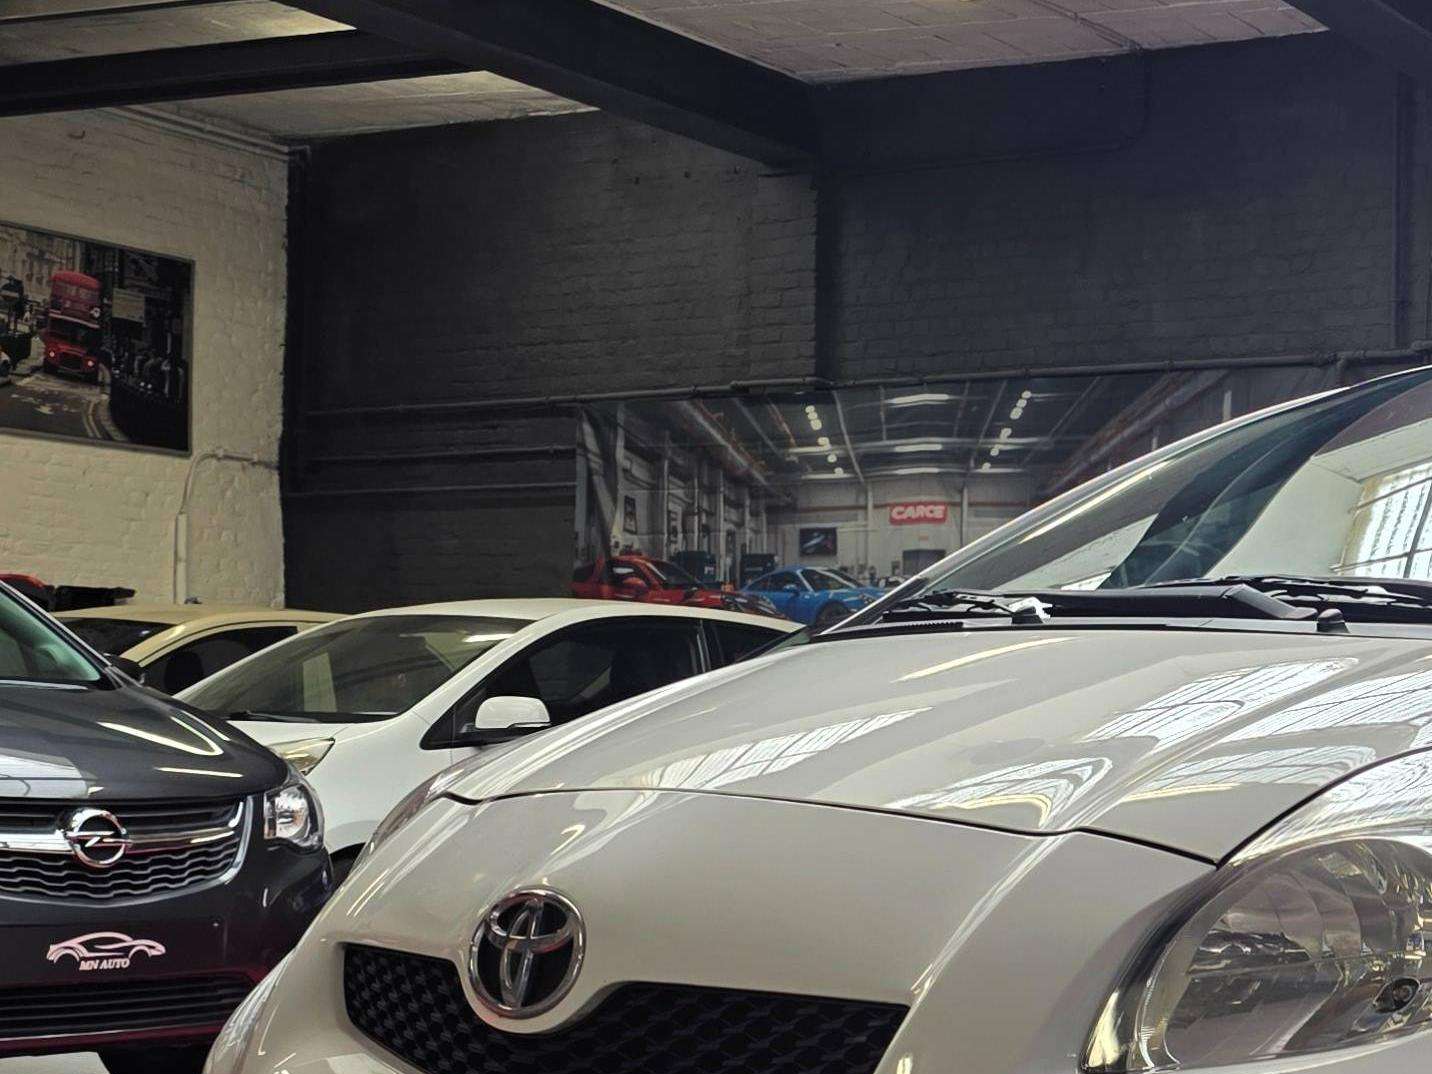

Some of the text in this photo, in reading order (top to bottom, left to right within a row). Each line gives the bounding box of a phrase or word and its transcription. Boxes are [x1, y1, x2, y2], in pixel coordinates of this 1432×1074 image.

[892, 505, 945, 519] CARCE
[79, 958, 130, 971] MN AUTO
